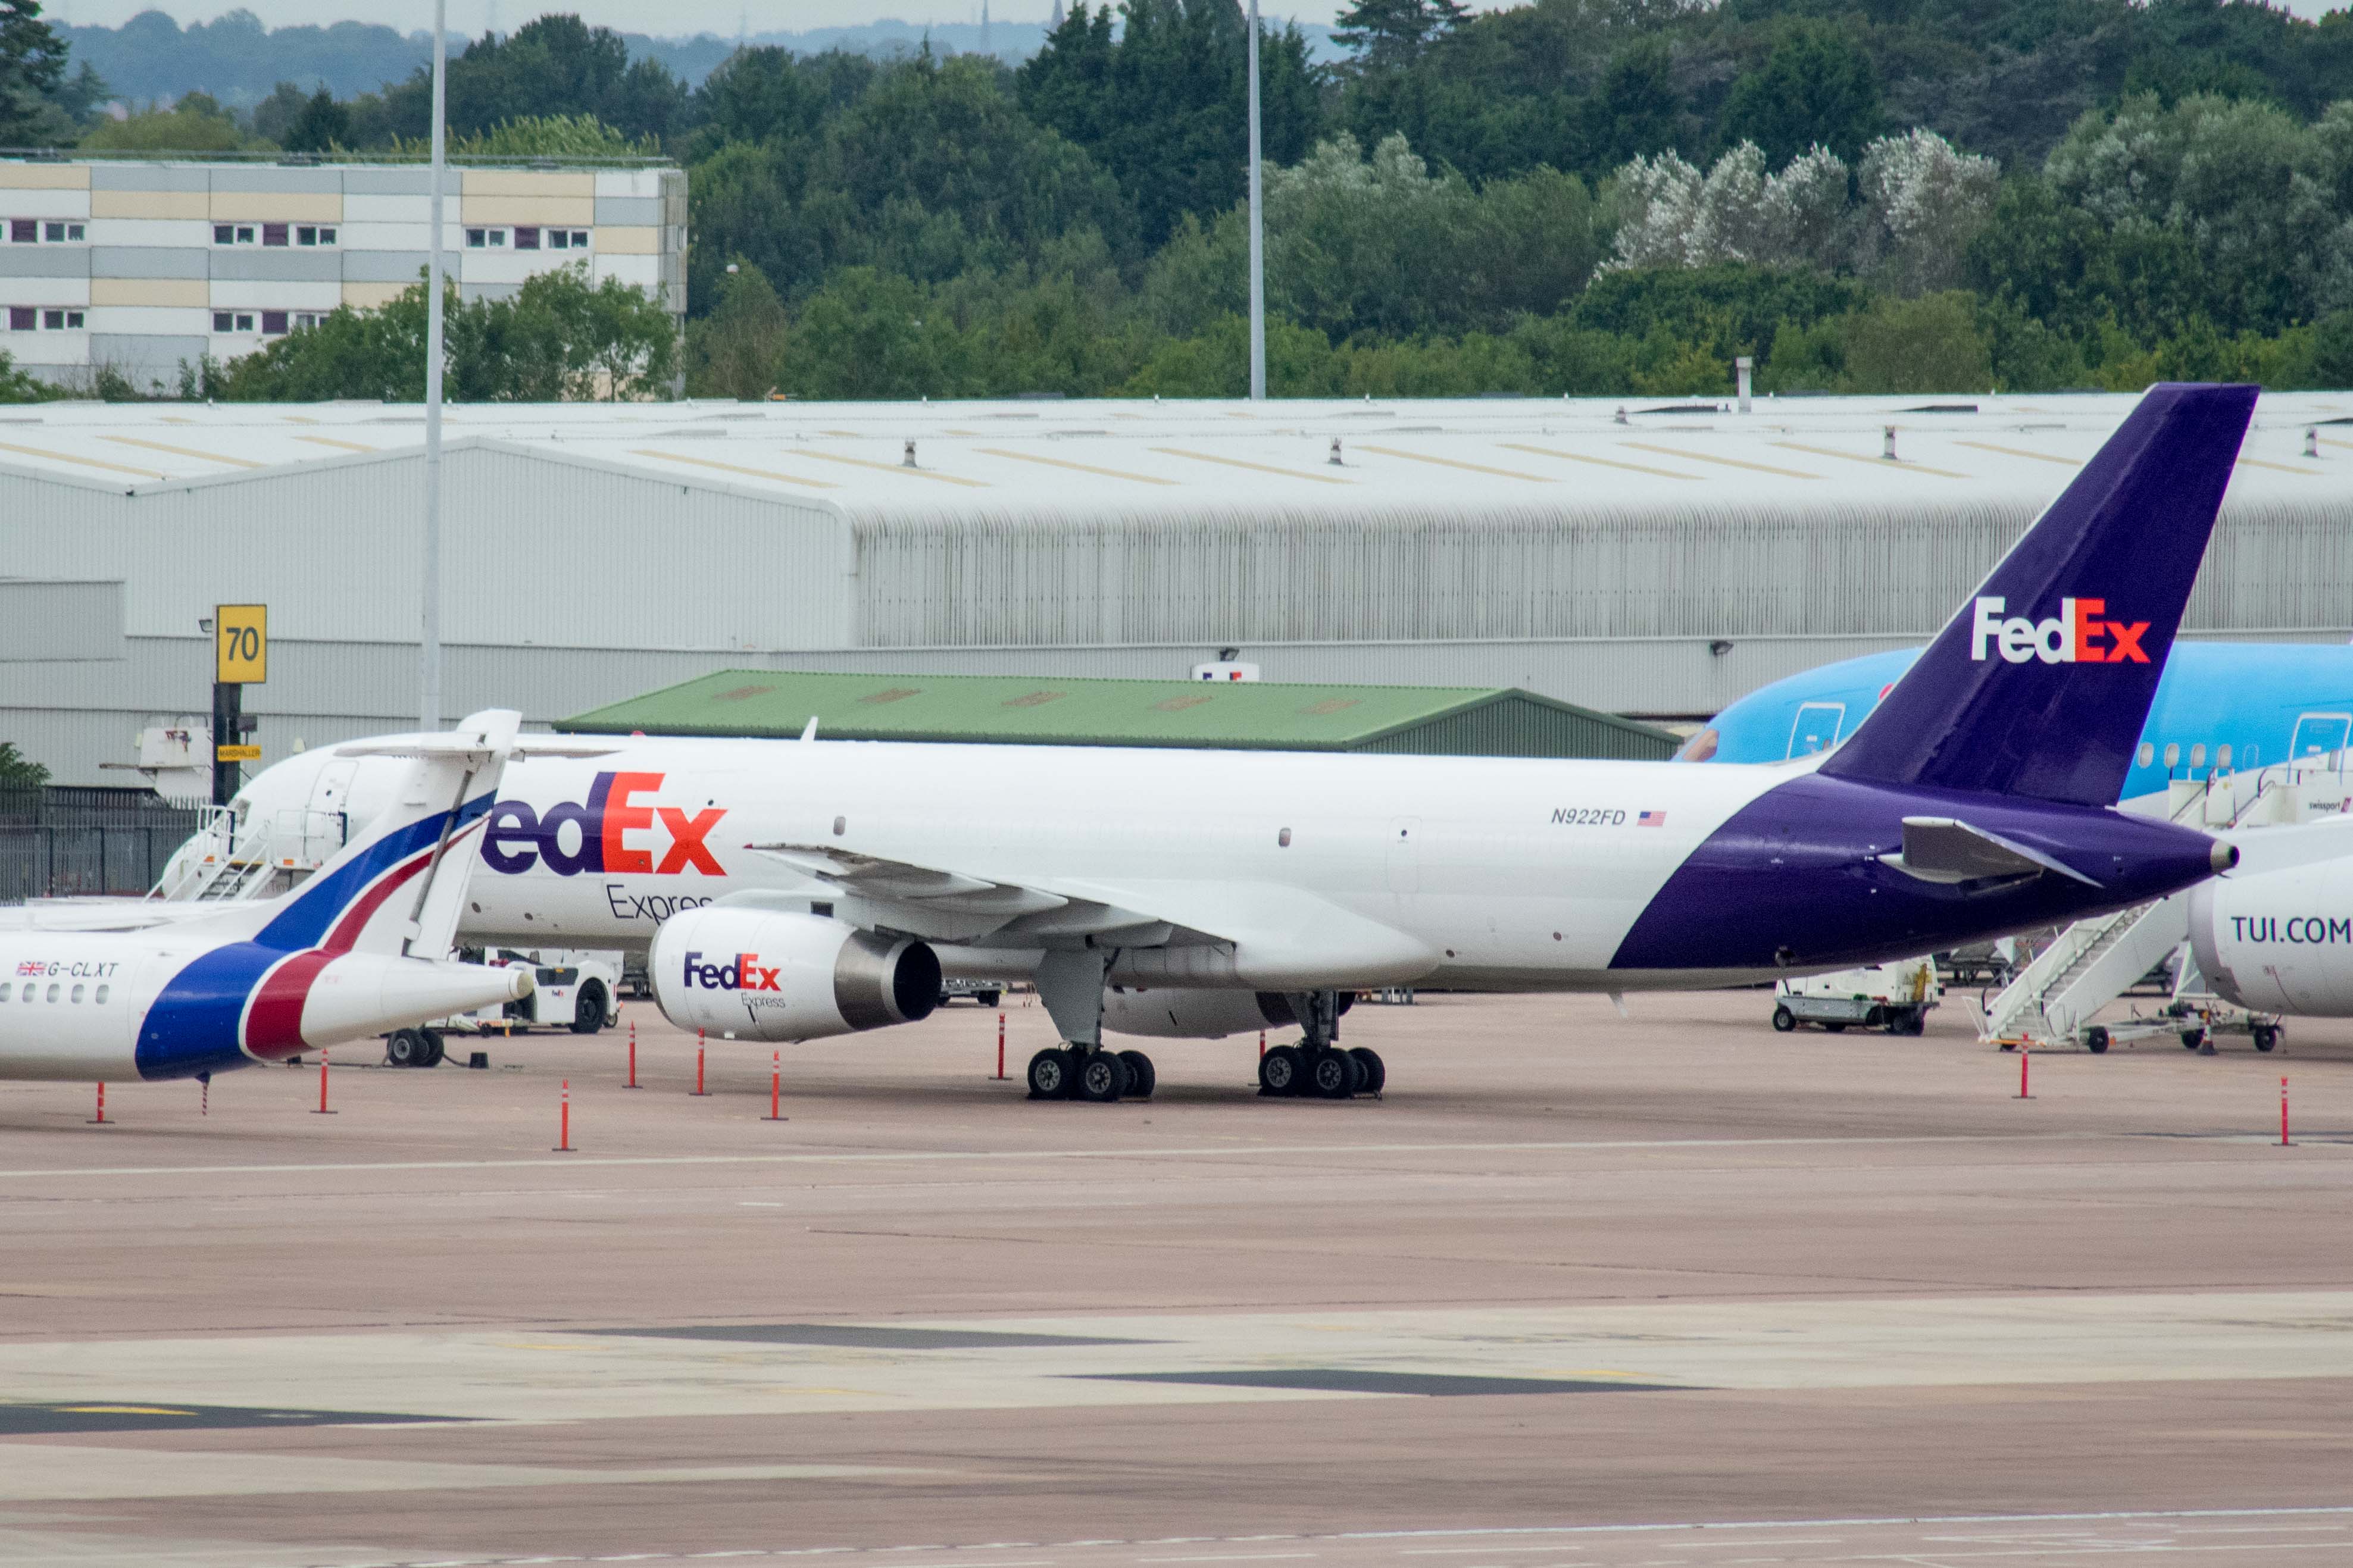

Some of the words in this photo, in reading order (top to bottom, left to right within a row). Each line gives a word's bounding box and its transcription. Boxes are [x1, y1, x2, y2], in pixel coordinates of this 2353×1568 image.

[1971, 596, 2151, 663] FedEx
[226, 627, 259, 661] 70
[1551, 808, 1626, 825] N922FD
[2309, 800, 2340, 813] swissport
[480, 772, 729, 876] edEx
[2231, 917, 2351, 943] TUI.COM
[48, 962, 119, 977] G-CLXT
[684, 952, 782, 991] FedEx
[742, 992, 786, 1009] Express
